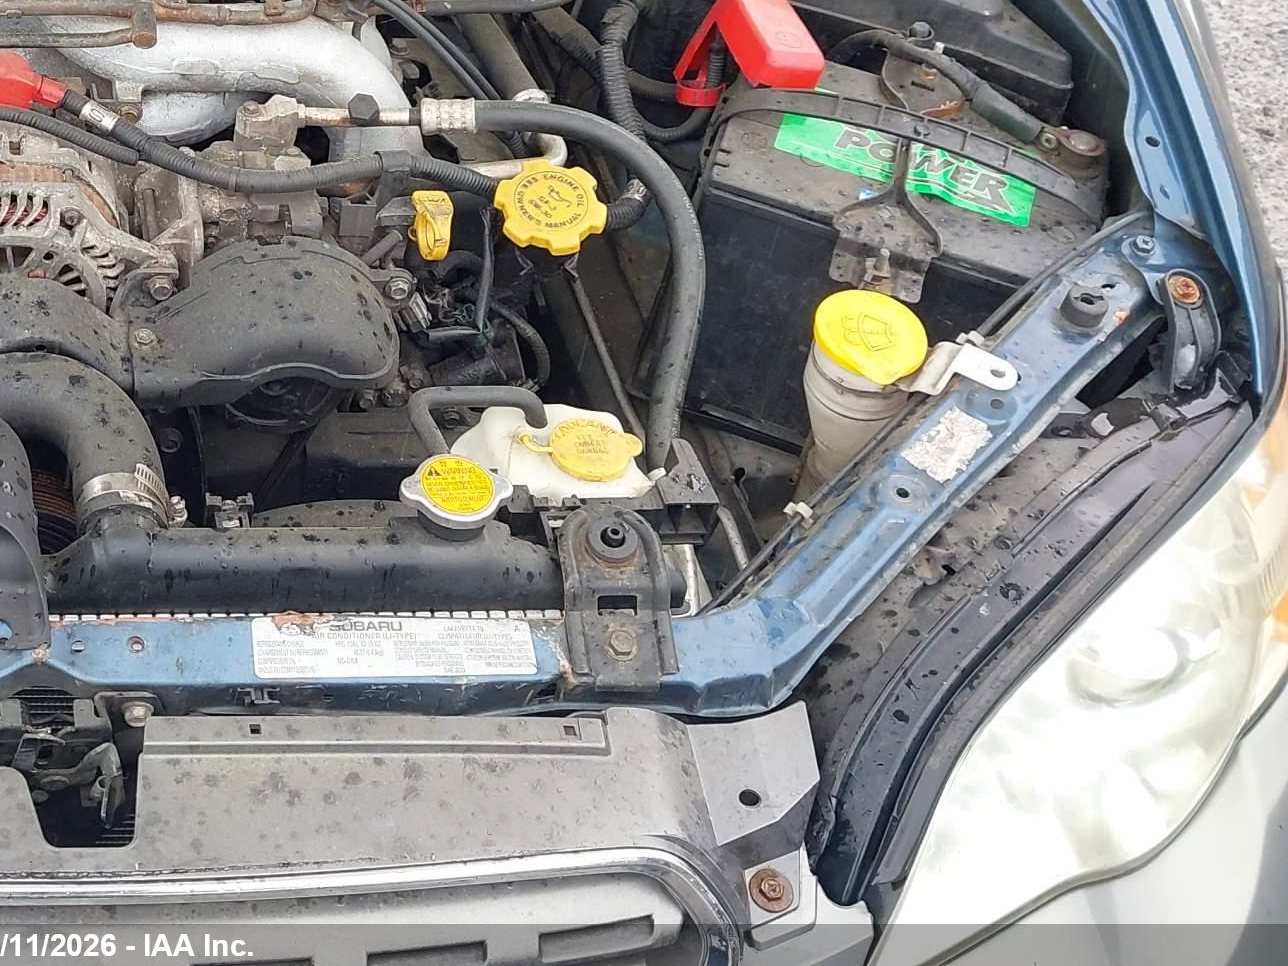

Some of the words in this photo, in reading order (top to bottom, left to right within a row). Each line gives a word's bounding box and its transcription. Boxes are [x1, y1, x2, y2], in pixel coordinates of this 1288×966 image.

[833, 129, 1017, 215] POWER
[576, 193, 585, 208] OIL
[329, 621, 403, 631] SUBARU
